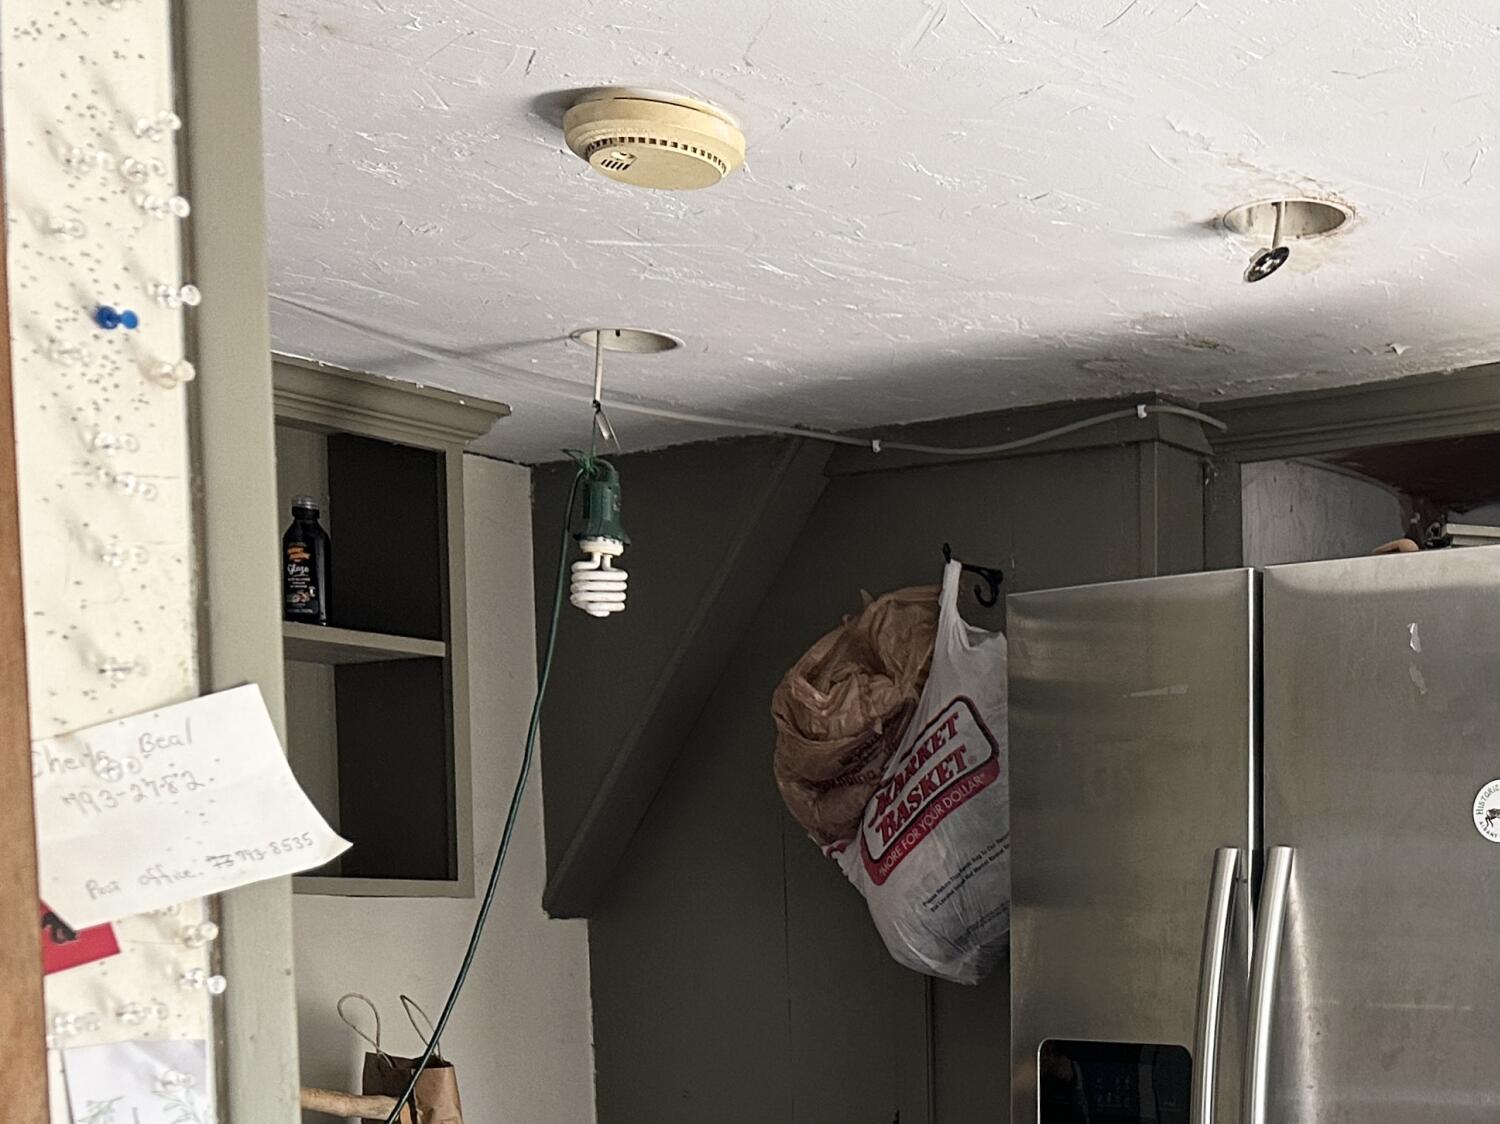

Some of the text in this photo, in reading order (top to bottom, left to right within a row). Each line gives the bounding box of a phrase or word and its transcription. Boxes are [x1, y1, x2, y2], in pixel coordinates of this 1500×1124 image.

[139, 716, 193, 754] Beal
[867, 711, 960, 829] MARKET
[875, 744, 968, 847] BASKET
[902, 828, 922, 850] FOR
[919, 803, 945, 831] YOUR
